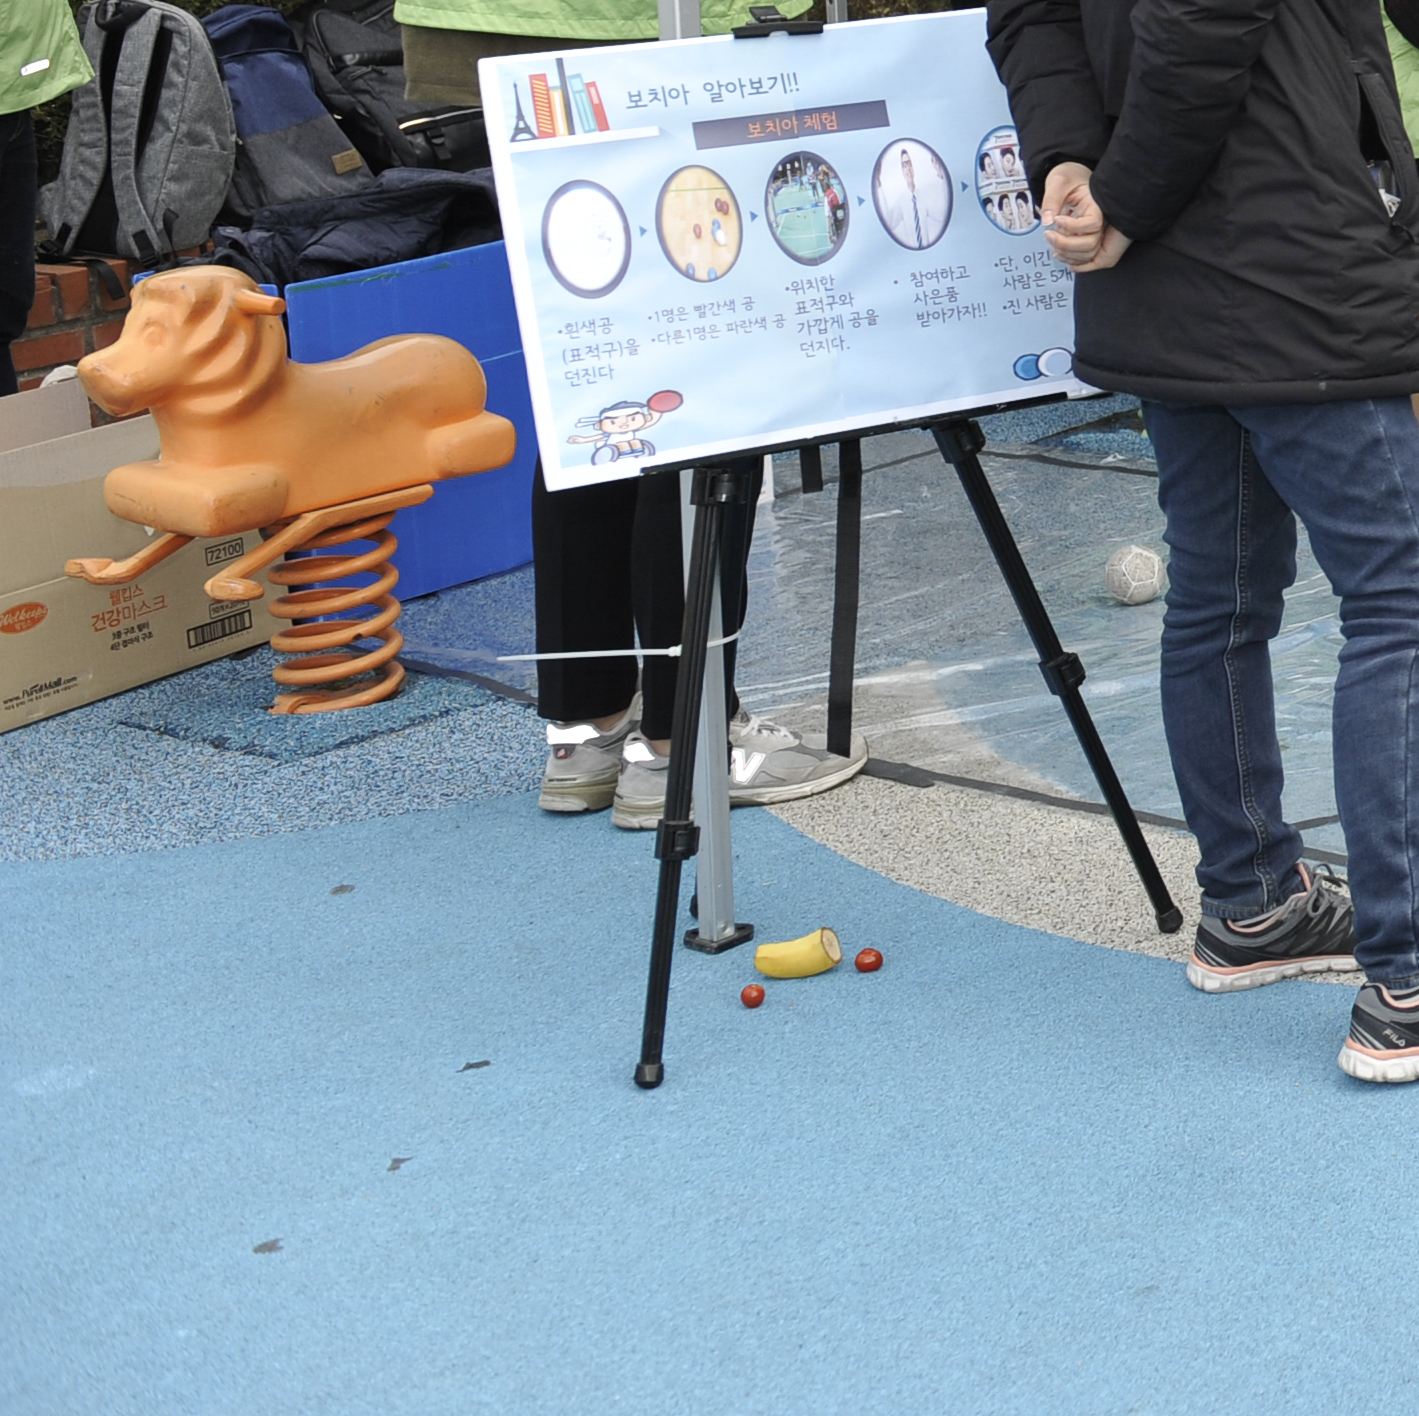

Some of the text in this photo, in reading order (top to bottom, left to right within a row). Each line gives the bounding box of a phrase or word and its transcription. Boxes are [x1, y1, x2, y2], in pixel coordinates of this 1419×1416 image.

[626, 72, 800, 109] 보치아 알아보기!!
[747, 110, 838, 138] 보치아 체험
[998, 249, 1052, 274] 단, 이긴
[790, 274, 835, 296] 위치한
[910, 265, 971, 288] 참여하고
[1003, 271, 1047, 291] 사람은
[795, 293, 855, 316] 표적구와
[913, 287, 960, 307] 사은품
[1007, 291, 1069, 316] 진 사람은
[655, 296, 756, 324] 1명은 빨간색 공
[797, 308, 879, 336] 가깝게 공을
[916, 302, 988, 328] 받아가자!!
[564, 316, 614, 340] 흰색공
[726, 315, 768, 335] 파란색
[772, 313, 787, 329] 공
[562, 338, 641, 365] (표적구)을
[800, 335, 851, 359] 던지다.
[564, 364, 615, 387] 던진다
[207, 542, 241, 561] 72100
[109, 584, 144, 606] 웰킵스
[91, 595, 168, 632] 건강마스크
[1382, 1027, 1406, 1047] FILA
